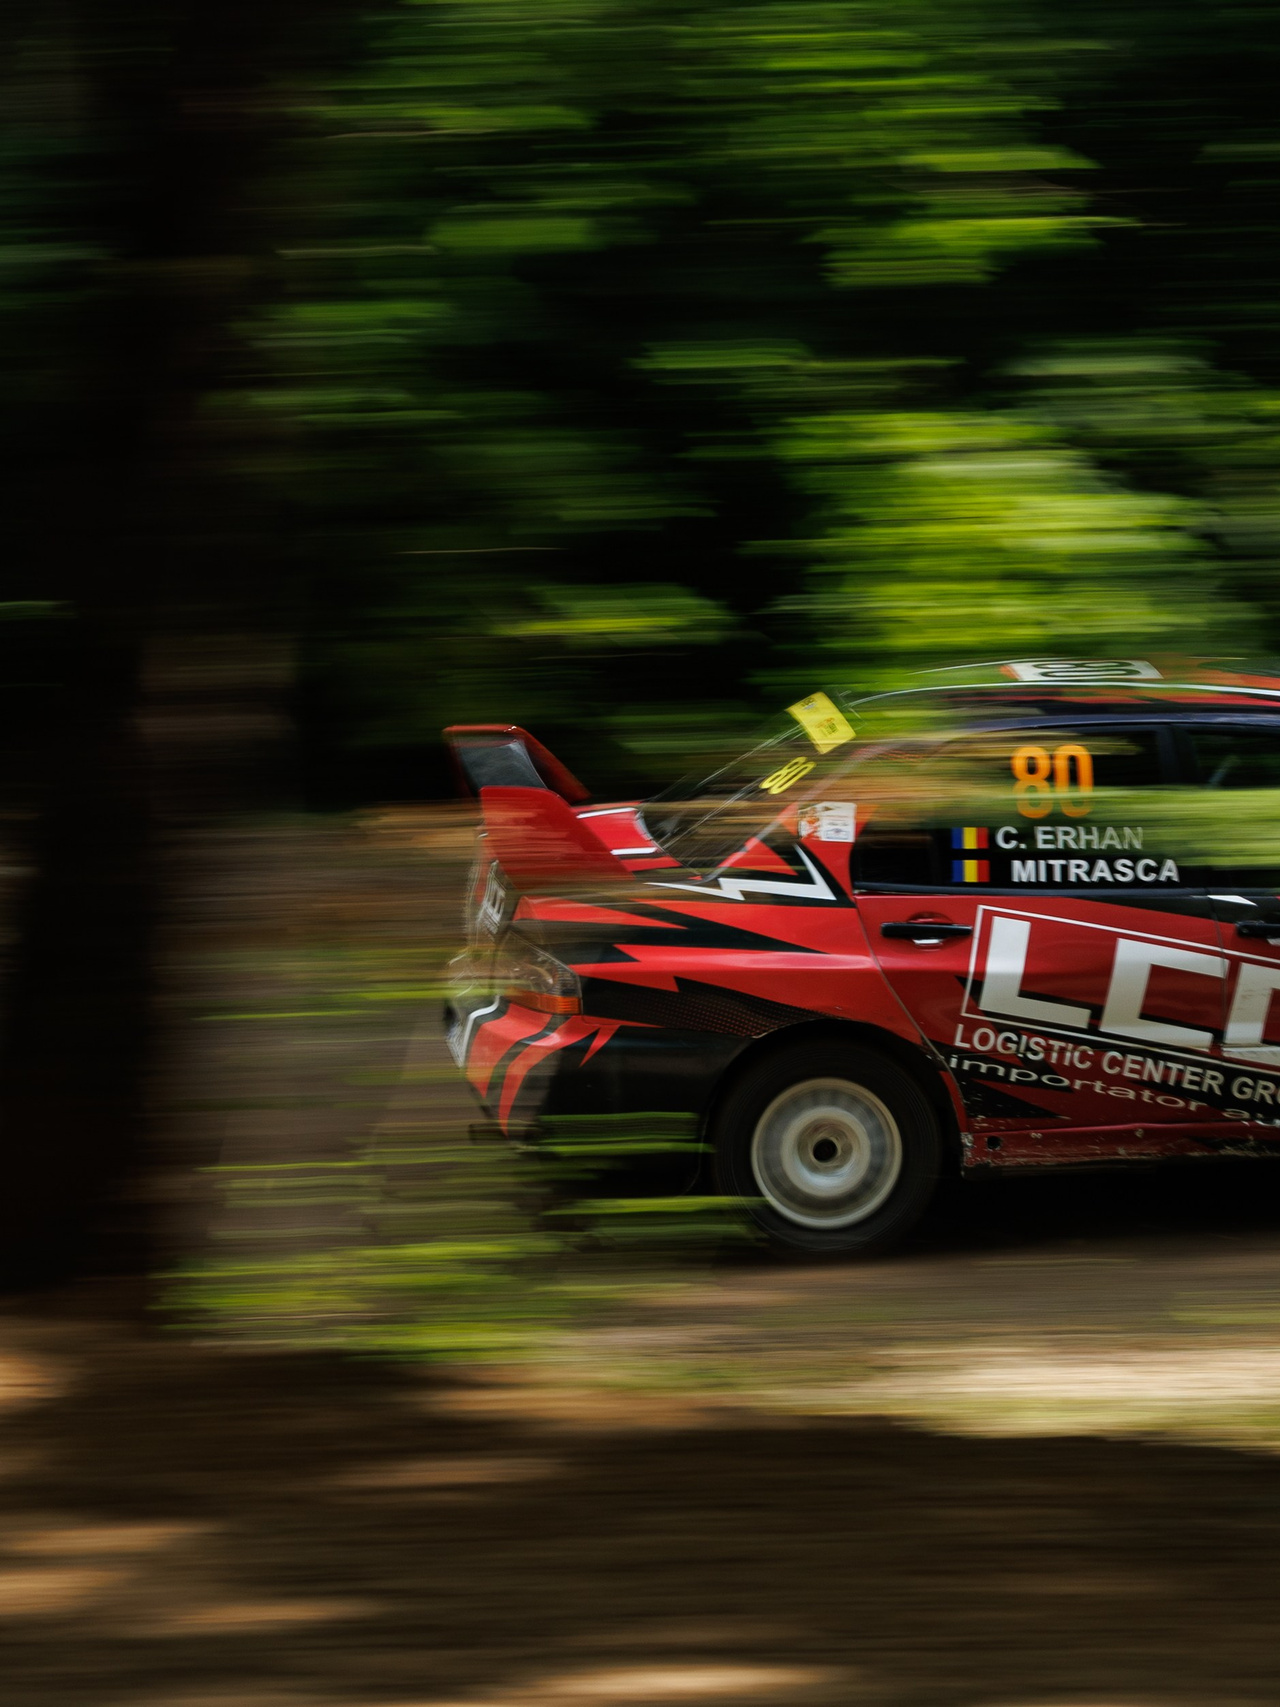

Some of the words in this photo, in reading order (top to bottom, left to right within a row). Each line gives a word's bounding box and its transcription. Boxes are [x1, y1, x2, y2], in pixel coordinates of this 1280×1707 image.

[759, 756, 817, 794] 80
[1010, 744, 1094, 818] 80
[995, 826, 1027, 849] C.
[1034, 826, 1144, 850] ERHAN
[1011, 859, 1180, 882] MITRASCA
[949, 1054, 1208, 1112] importator
[954, 1023, 1095, 1070] LOGISTIC
[1102, 1050, 1223, 1095] CENTER
